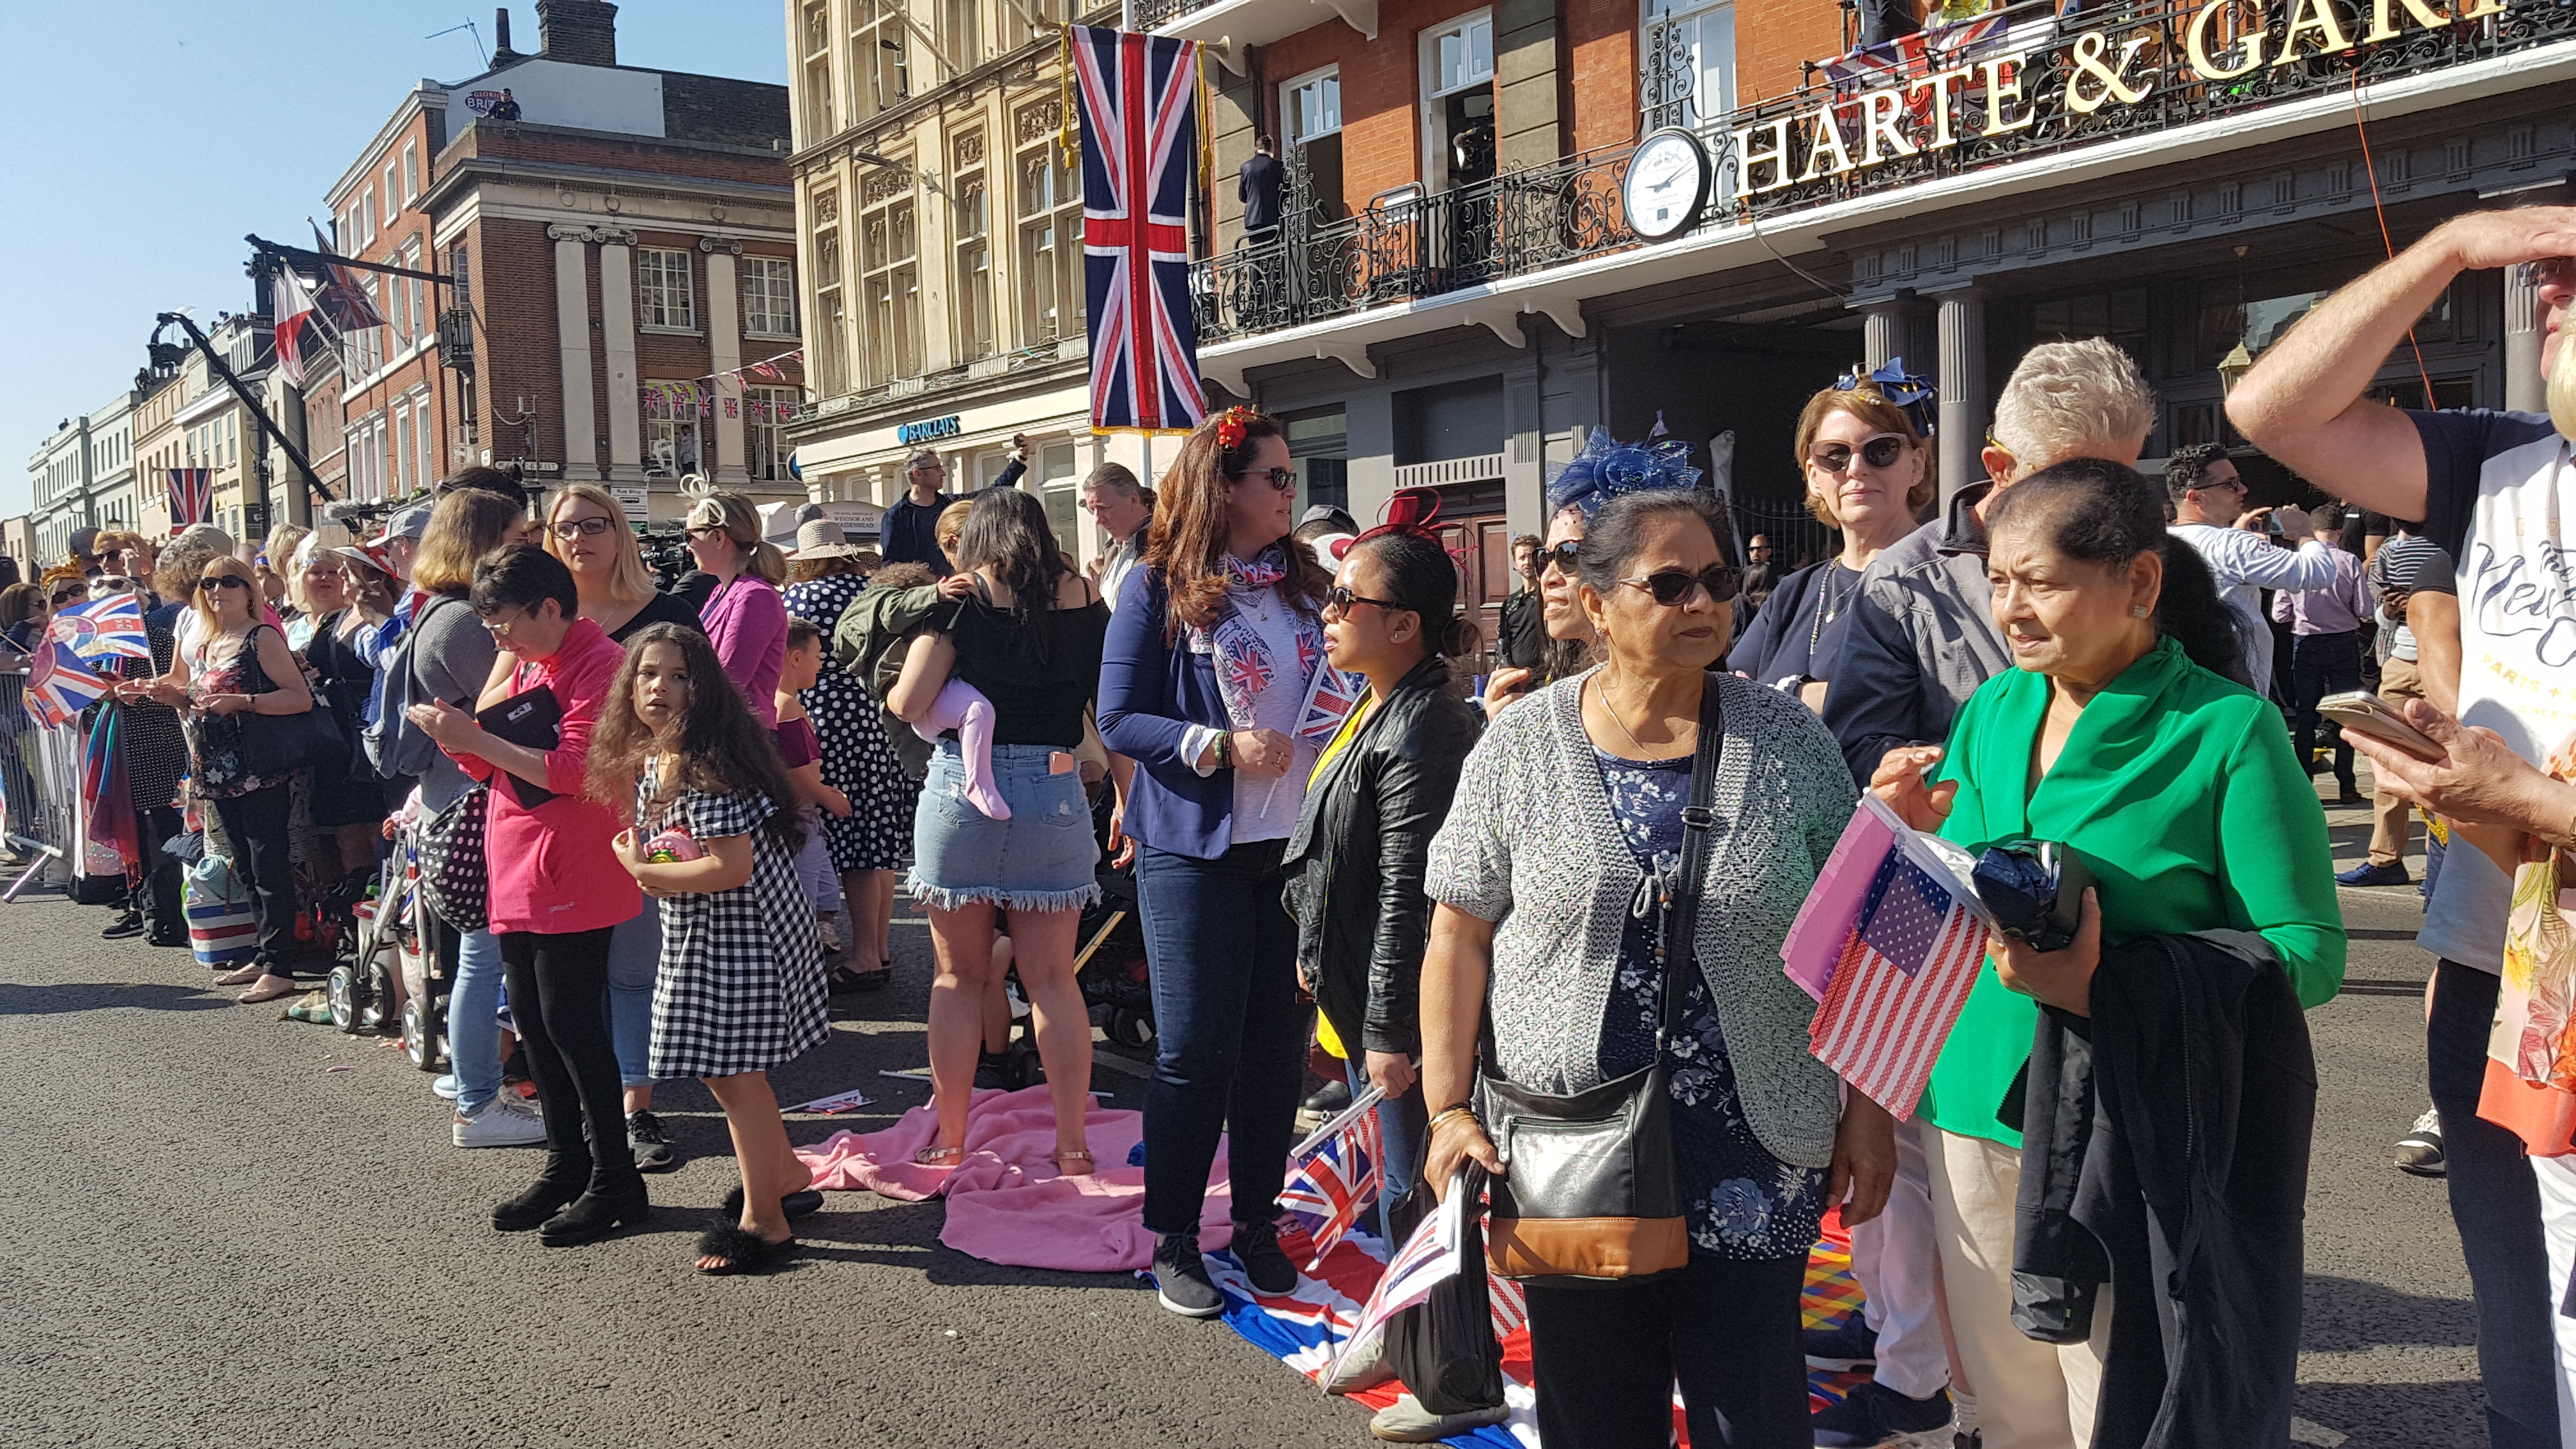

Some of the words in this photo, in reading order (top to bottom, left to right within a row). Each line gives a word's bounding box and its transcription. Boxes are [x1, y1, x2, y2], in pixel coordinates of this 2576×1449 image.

[467, 98, 496, 110] BRIT
[1731, 50, 2035, 199] HARTE
[2067, 31, 2153, 113] &
[2186, 0, 2508, 80] GAR
[908, 415, 958, 440] BARCLAYS
[2483, 652, 2542, 693] PARTS
